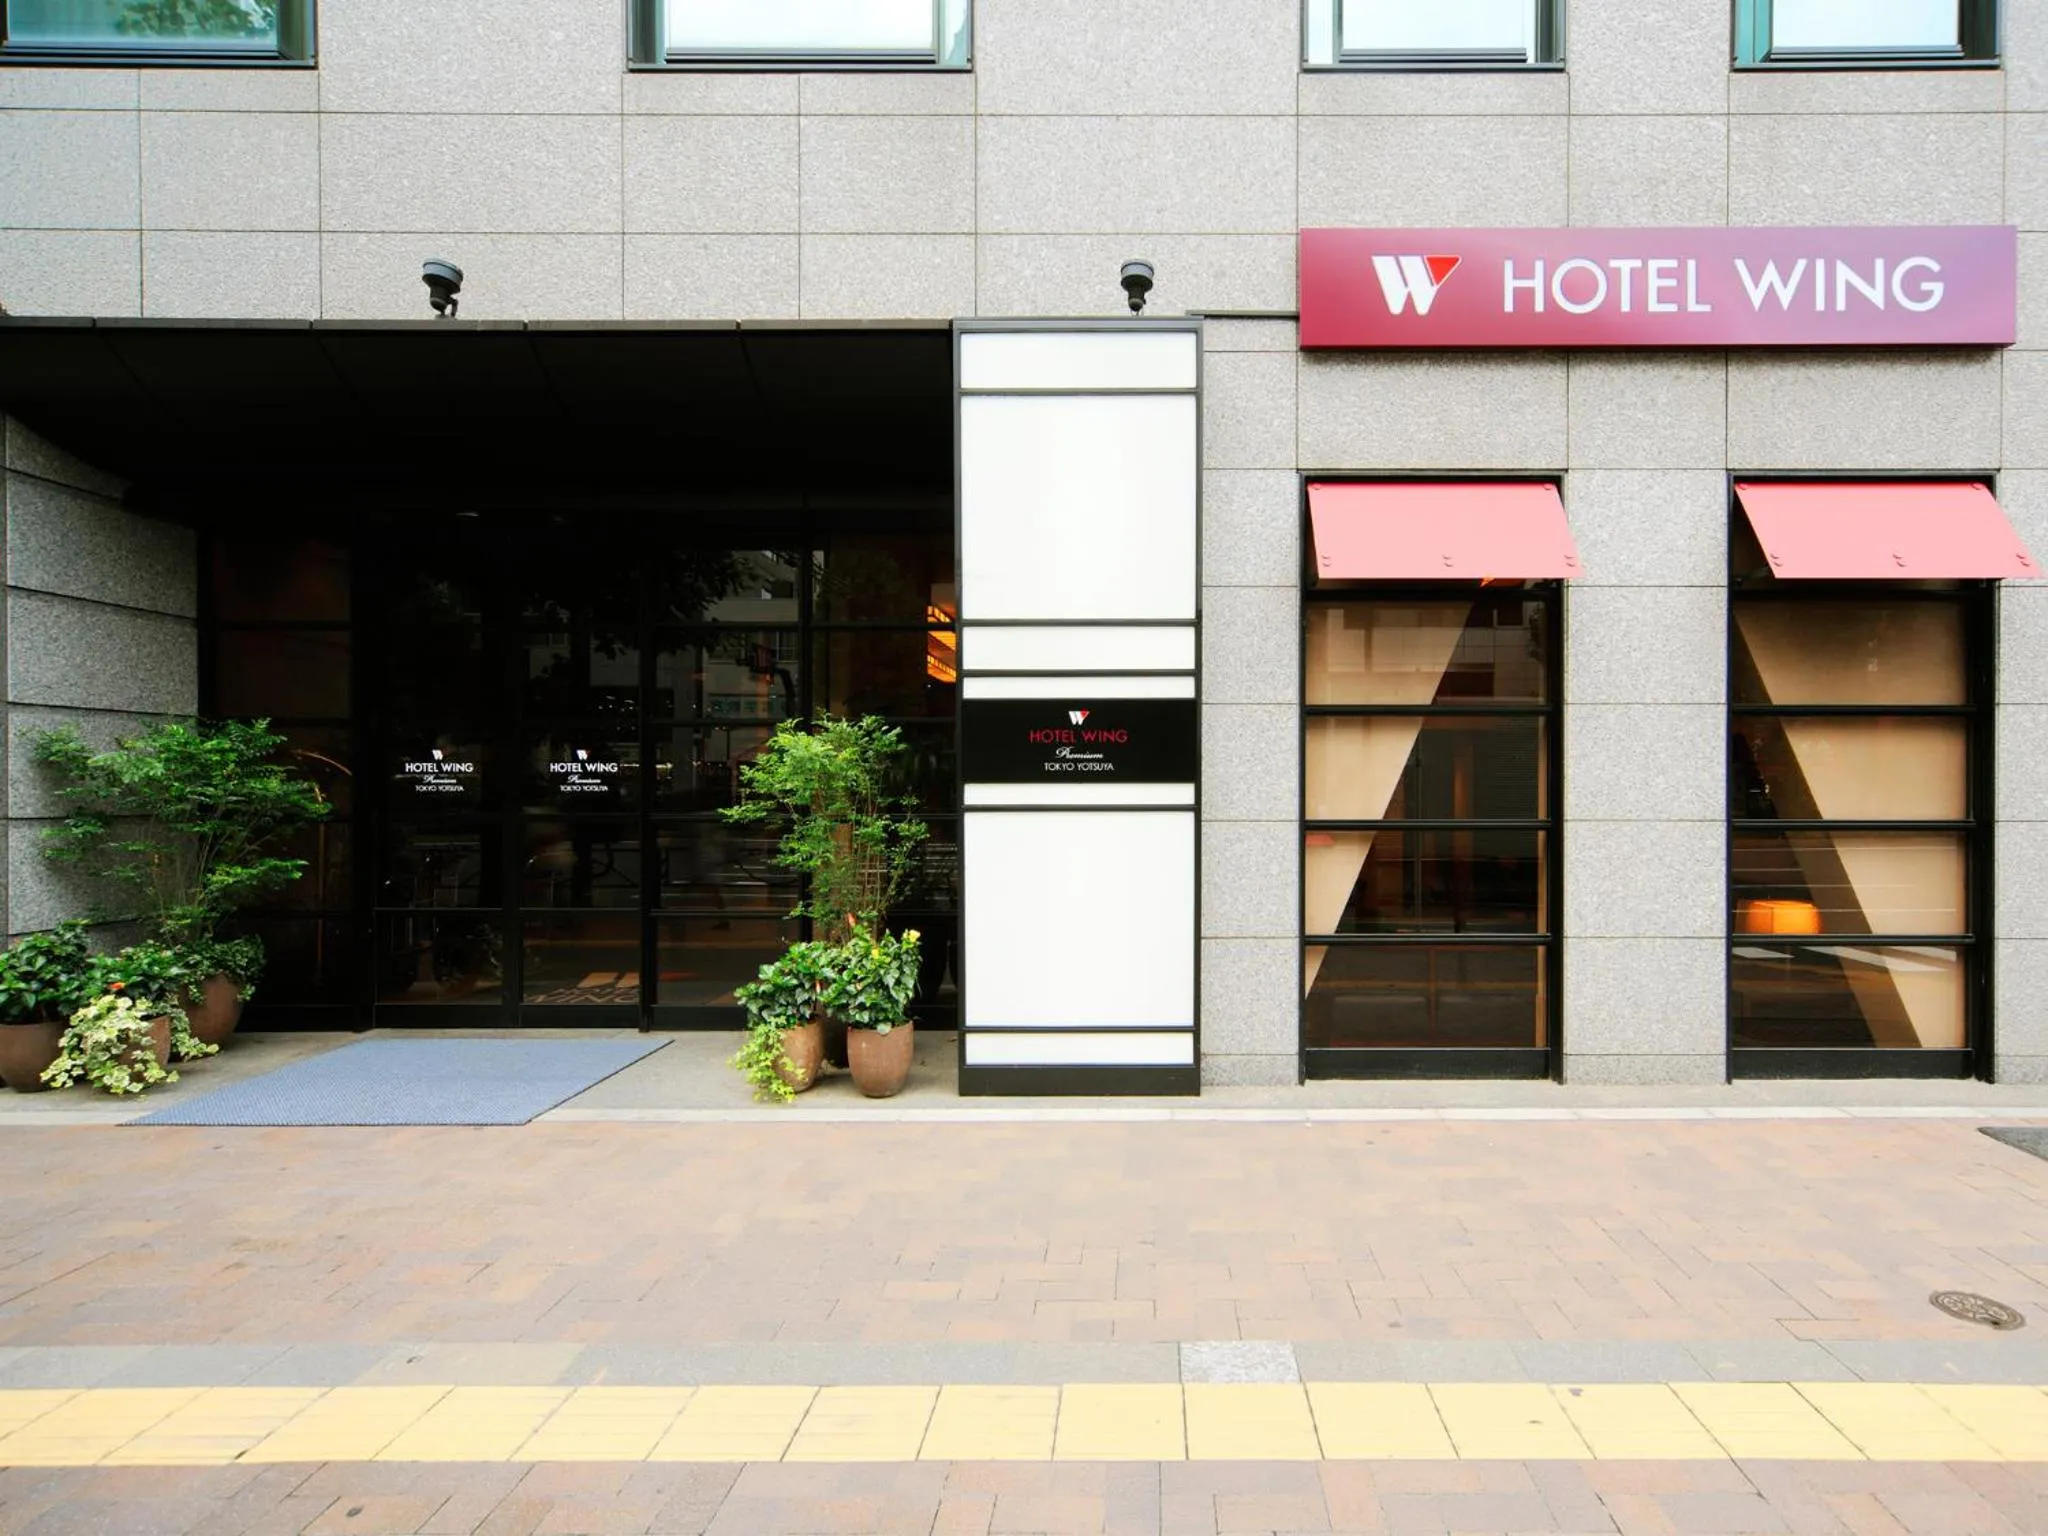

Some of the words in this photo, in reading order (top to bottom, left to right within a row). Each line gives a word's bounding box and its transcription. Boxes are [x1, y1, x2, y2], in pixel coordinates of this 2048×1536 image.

[1503, 257, 1712, 314] HOTEL
[1734, 256, 1945, 314] WING
[1029, 730, 1076, 744] HOTEL
[1082, 730, 1129, 744] WING
[1055, 746, 1104, 759] Premium
[405, 762, 439, 773] HOTEL
[441, 762, 475, 773] WING
[549, 762, 583, 773] HOTEL
[585, 761, 619, 773] WING
[1043, 762, 1076, 772] TOKYO
[1077, 762, 1115, 772] YOTSUYA
